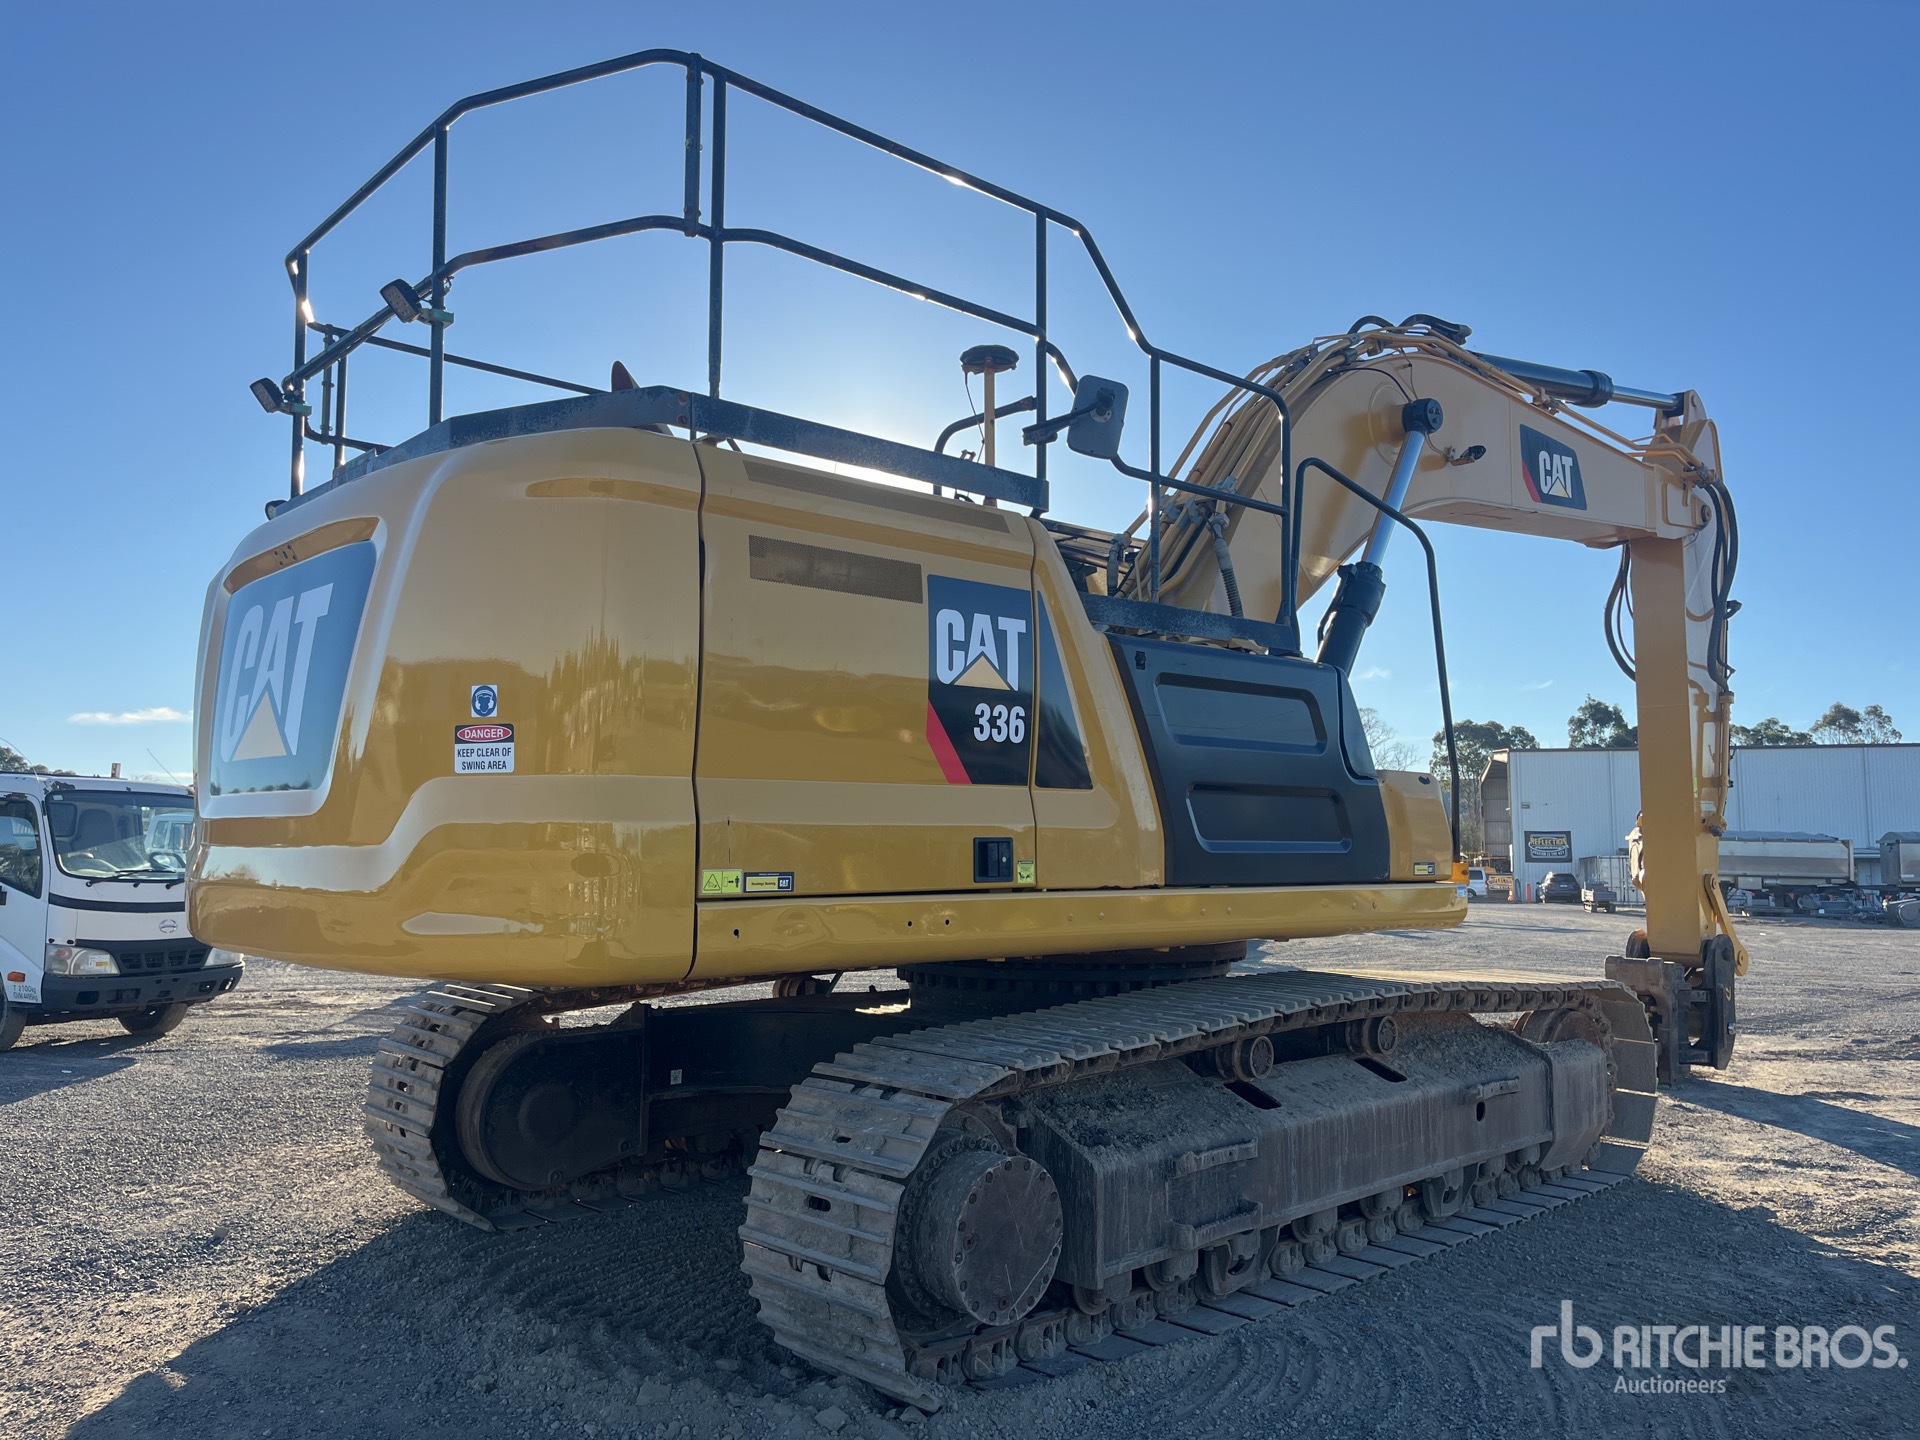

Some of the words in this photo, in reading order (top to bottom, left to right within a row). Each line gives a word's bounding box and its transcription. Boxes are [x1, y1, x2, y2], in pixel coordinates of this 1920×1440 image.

[1538, 450, 1573, 499] CAT
[935, 608, 1026, 692] CAT
[220, 582, 334, 763] CAT
[464, 728, 504, 739] DANGER
[973, 702, 1026, 744] 336
[457, 748, 475, 758] KEEP
[476, 747, 500, 758] CLEAR
[501, 747, 512, 757] OF
[461, 761, 486, 771] SWING
[487, 760, 507, 770] AREA
[1530, 837, 1566, 845] REFLECTION
